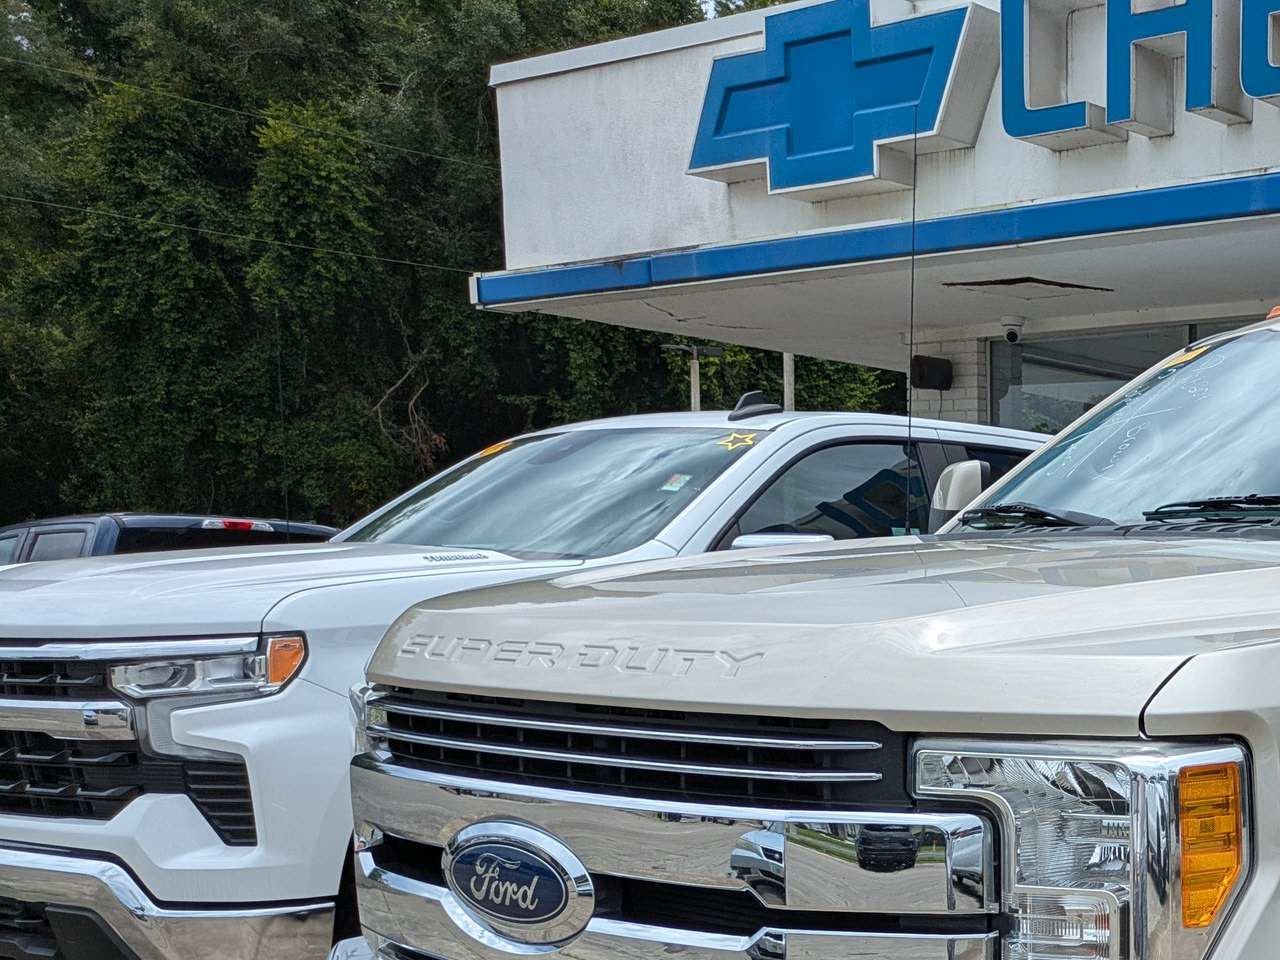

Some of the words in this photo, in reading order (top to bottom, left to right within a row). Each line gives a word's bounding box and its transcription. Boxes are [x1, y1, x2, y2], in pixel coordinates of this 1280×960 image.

[400, 633, 564, 670] SUPER
[570, 644, 765, 678] DUTY
[470, 852, 540, 910] Ford
